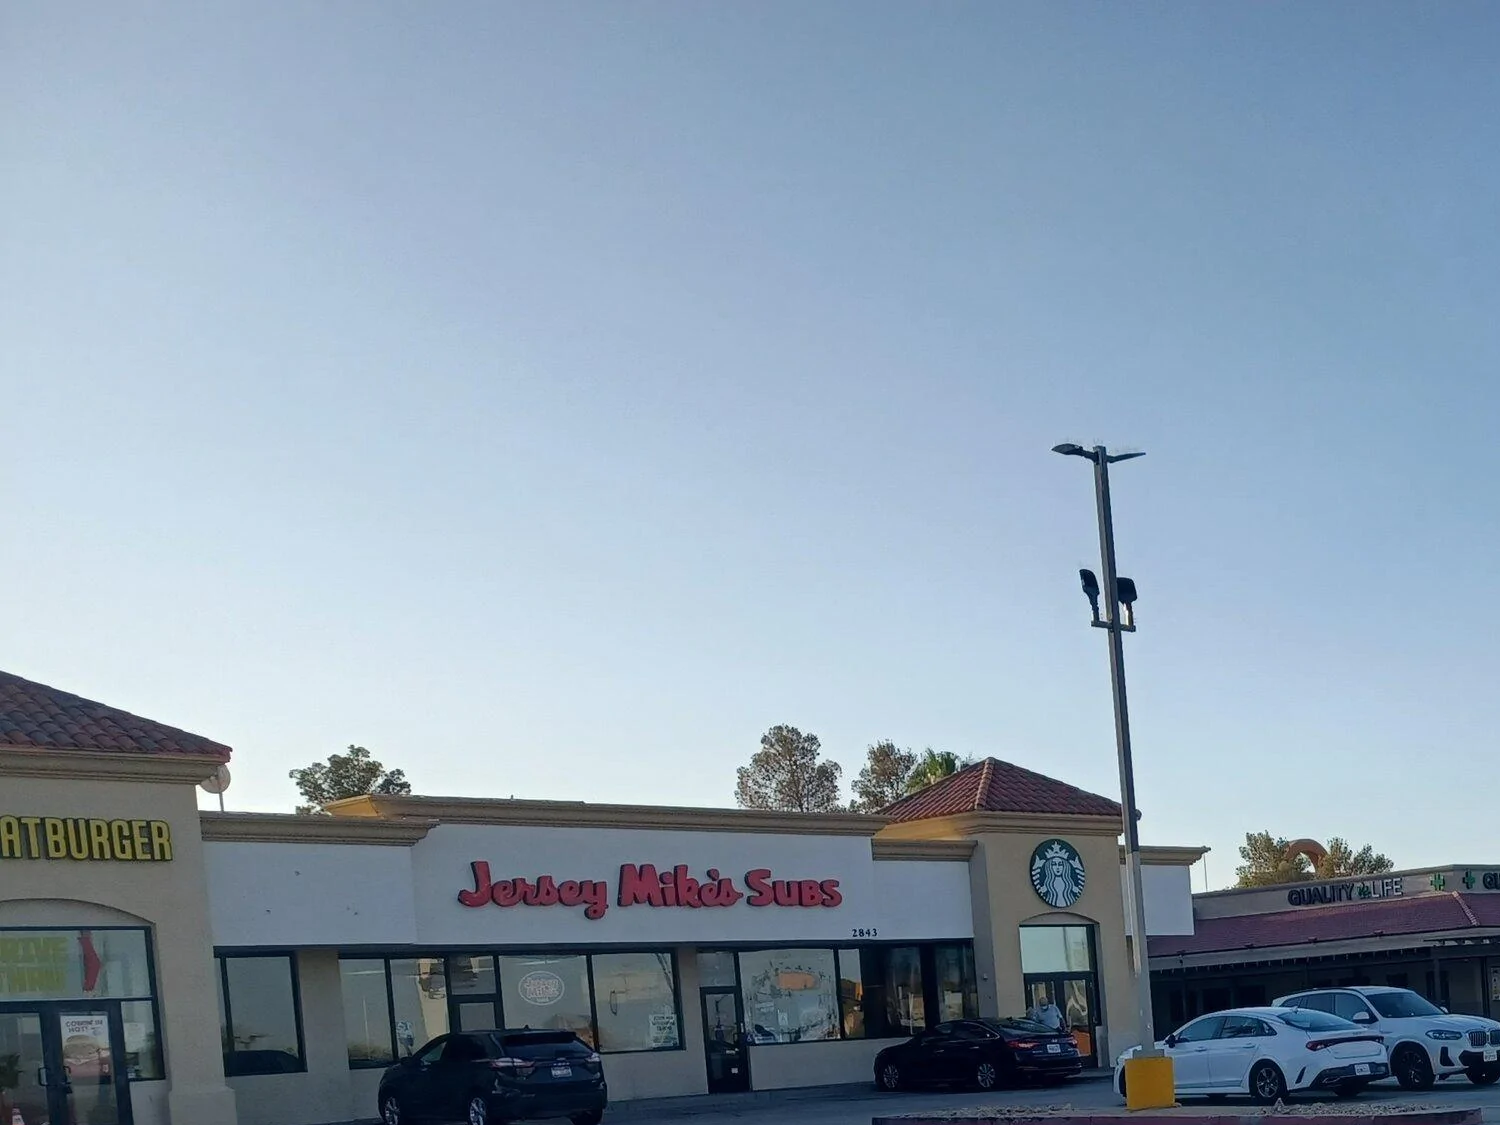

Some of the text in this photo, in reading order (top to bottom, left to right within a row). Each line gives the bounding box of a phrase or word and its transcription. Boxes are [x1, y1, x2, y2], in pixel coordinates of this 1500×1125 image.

[458, 861, 609, 920] Jersey
[617, 863, 744, 908] Mike's
[1287, 878, 1404, 906] QUALITY LIFE
[851, 928, 877, 937] 2843
